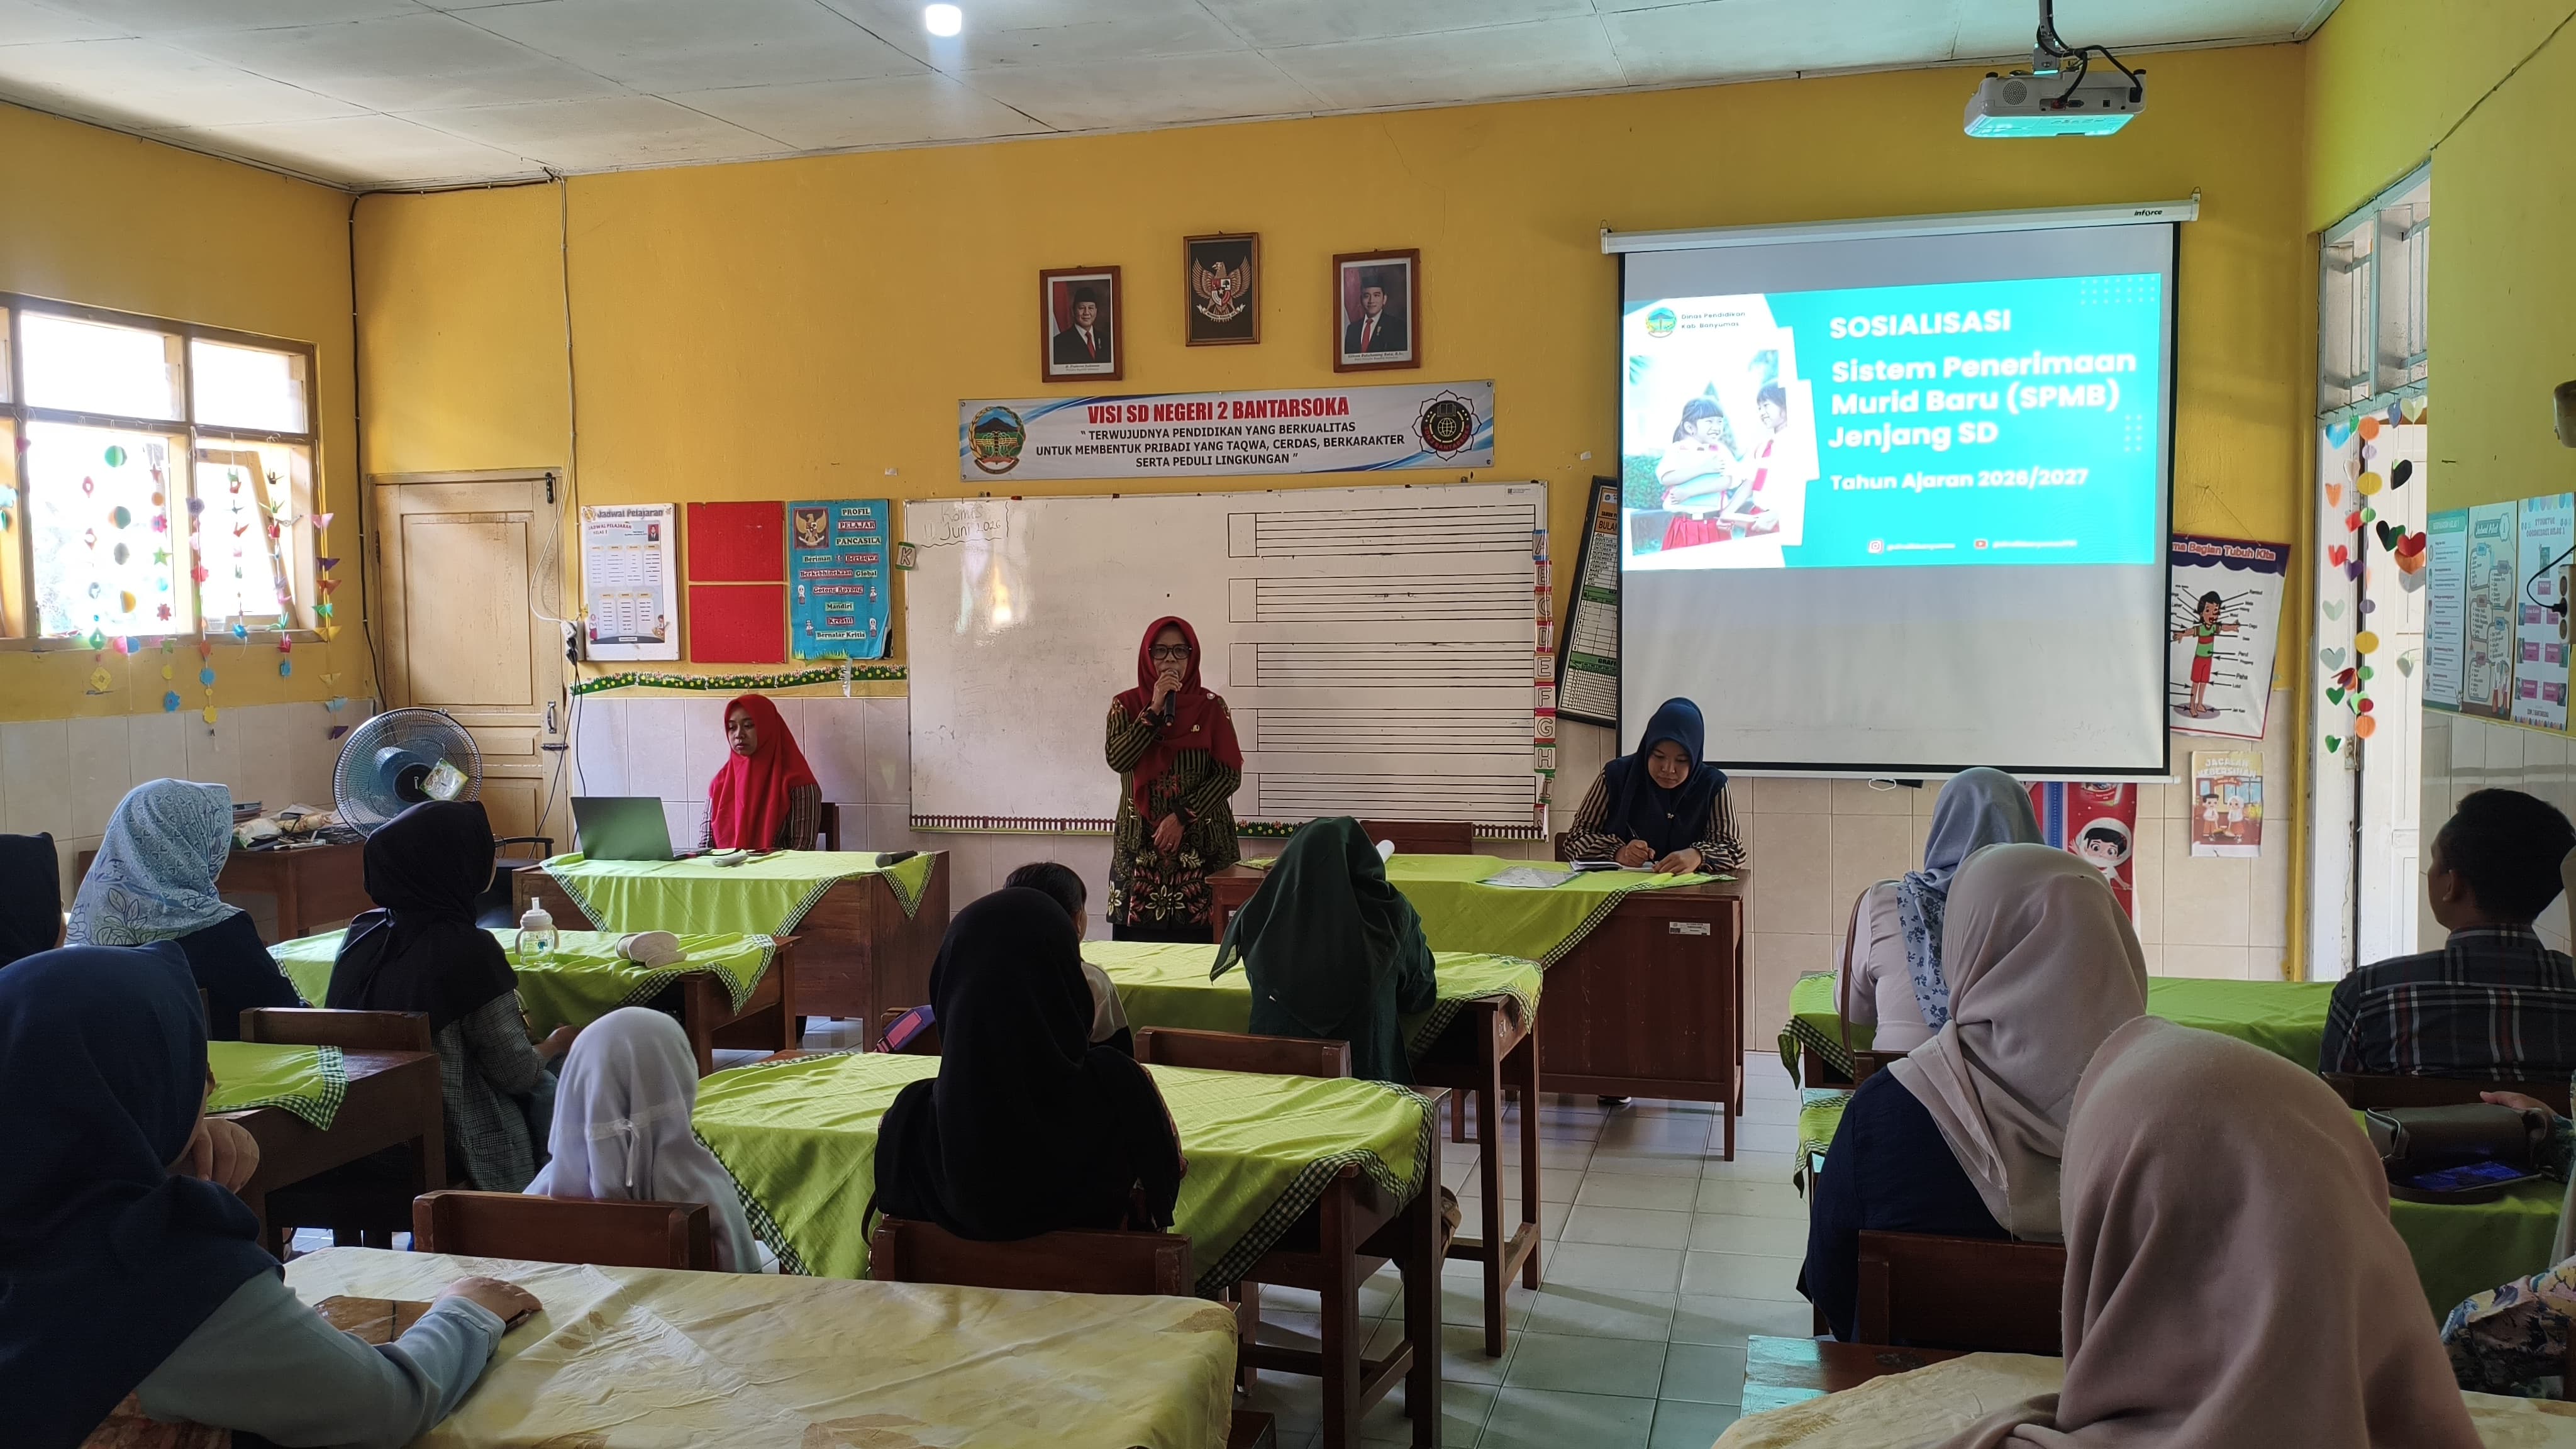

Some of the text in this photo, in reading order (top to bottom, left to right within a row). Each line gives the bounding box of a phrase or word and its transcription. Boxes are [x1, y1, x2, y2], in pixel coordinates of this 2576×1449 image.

[1829, 309, 2011, 340] SOSIALISASI
[1831, 350, 2137, 384] Sistem Penerimaan
[1831, 377, 2120, 416] Murid Baru (SPMB)
[1087, 397, 1350, 424] VISI SD NEGERI 2 BANTARSOKA
[1089, 428, 1170, 440] TERWUJUDNYA
[1173, 426, 1242, 438] PENDIDIKAN
[1245, 425, 1276, 436] YANG
[1279, 422, 1356, 435] BERKUALITAS
[1828, 421, 1999, 453] Jenjang SD
[1036, 435, 1405, 456] UNTUK MEMBENTUK PRIBADI YANG TAQWA, CERDAS, BERKARAKTER
[1136, 457, 1170, 468] SERTA
[1173, 456, 1213, 467] PEDULI
[1215, 454, 1290, 465] LINGKUNGAN
[1830, 466, 2089, 494] Tahun Ajaran 2026/2027
[597, 508, 663, 519] Jadwal Pelajaran
[941, 504, 984, 523] Kamis
[940, 522, 970, 541] Juni
[976, 520, 1001, 532] 2026
[836, 537, 881, 545] PANCASILA
[1535, 533, 1549, 555] A
[2172, 541, 2276, 561] ma Bagian Tubuh Kita
[846, 555, 879, 563] Bertaqwa
[901, 547, 912, 565] K
[1537, 565, 1550, 586] B
[1538, 597, 1550, 616] C
[1538, 626, 1552, 646] D
[1537, 657, 1552, 677] E
[1538, 687, 1552, 708] F
[1536, 718, 1553, 737] G
[1538, 748, 1552, 768] H
[1539, 779, 1552, 799] I
